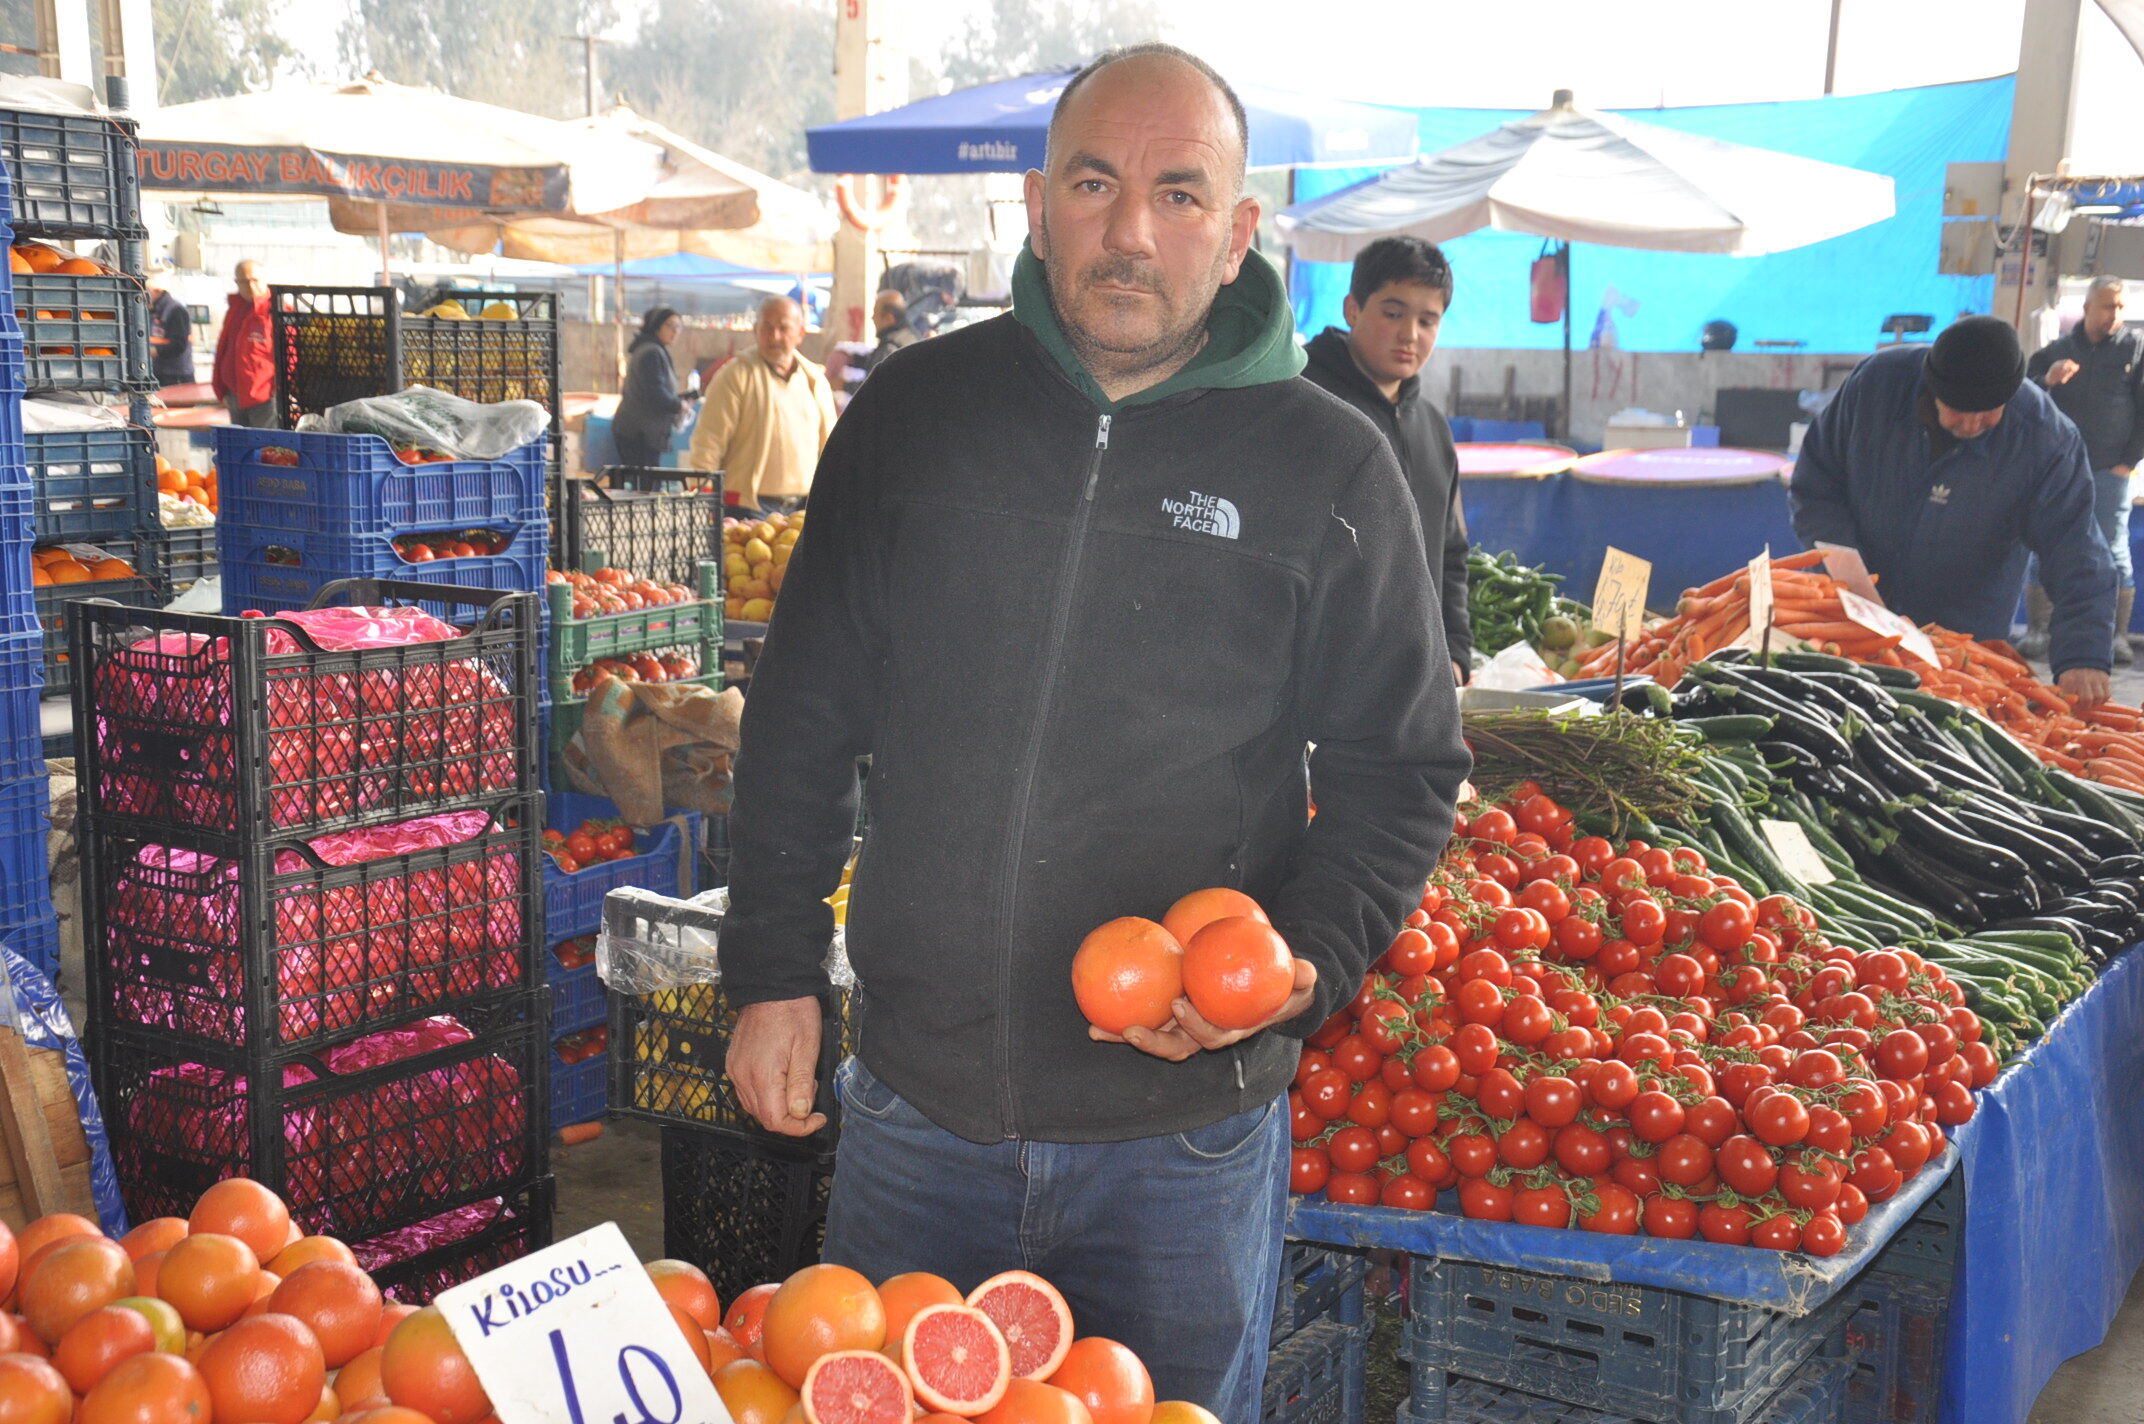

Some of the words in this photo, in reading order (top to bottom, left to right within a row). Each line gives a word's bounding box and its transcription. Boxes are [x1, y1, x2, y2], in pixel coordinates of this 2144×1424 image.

[136, 149, 271, 182] TURGAY
[278, 152, 474, 199] BALIKÇILIK
[1161, 498, 1215, 520] NORTH
[1189, 490, 1218, 509] THE
[1173, 515, 1212, 534] FACE
[1481, 1268, 1554, 1300] BABA
[1564, 1285, 1643, 1319] SEDO
